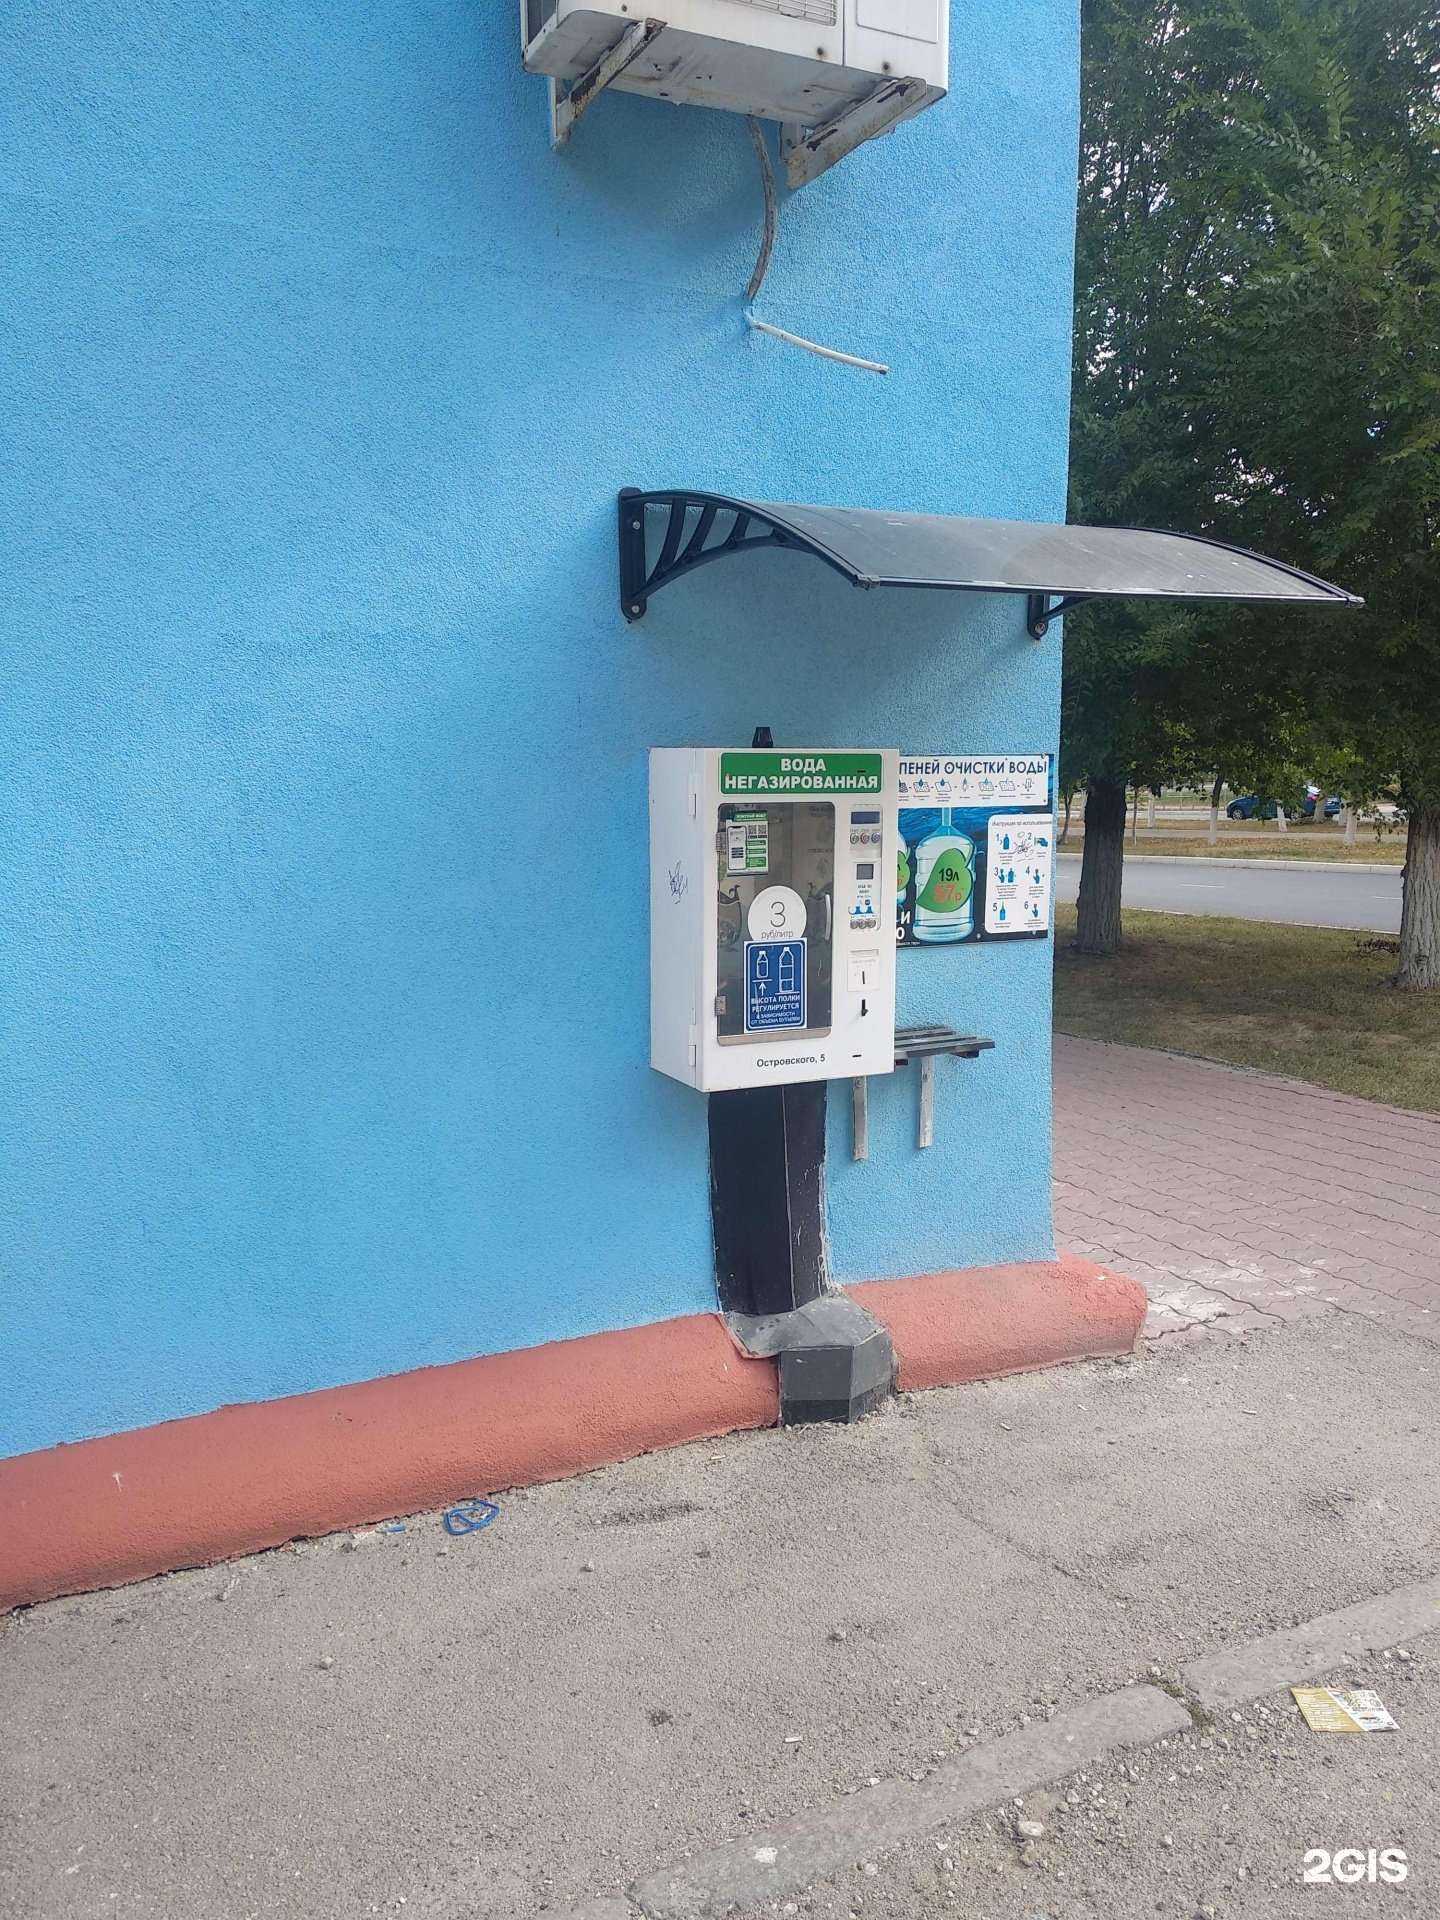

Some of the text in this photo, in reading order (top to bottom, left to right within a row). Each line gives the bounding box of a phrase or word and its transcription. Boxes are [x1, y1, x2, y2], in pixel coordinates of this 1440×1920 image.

[780, 758, 826, 773] ВОДА
[944, 761, 1004, 774] ОЧИСТКИ
[1009, 760, 1047, 774] ВОДЫ
[724, 775, 878, 789] НЕГАЗИРОВАННАЯ
[938, 867, 959, 882] 19л
[993, 866, 999, 876] 3
[992, 902, 998, 912] 5
[770, 901, 786, 928] 3
[778, 994, 800, 1003] ПОЛКИ
[751, 1002, 800, 1012] РЕГУЛИРУЕТСЯ
[756, 1054, 826, 1068] Островского, 5
